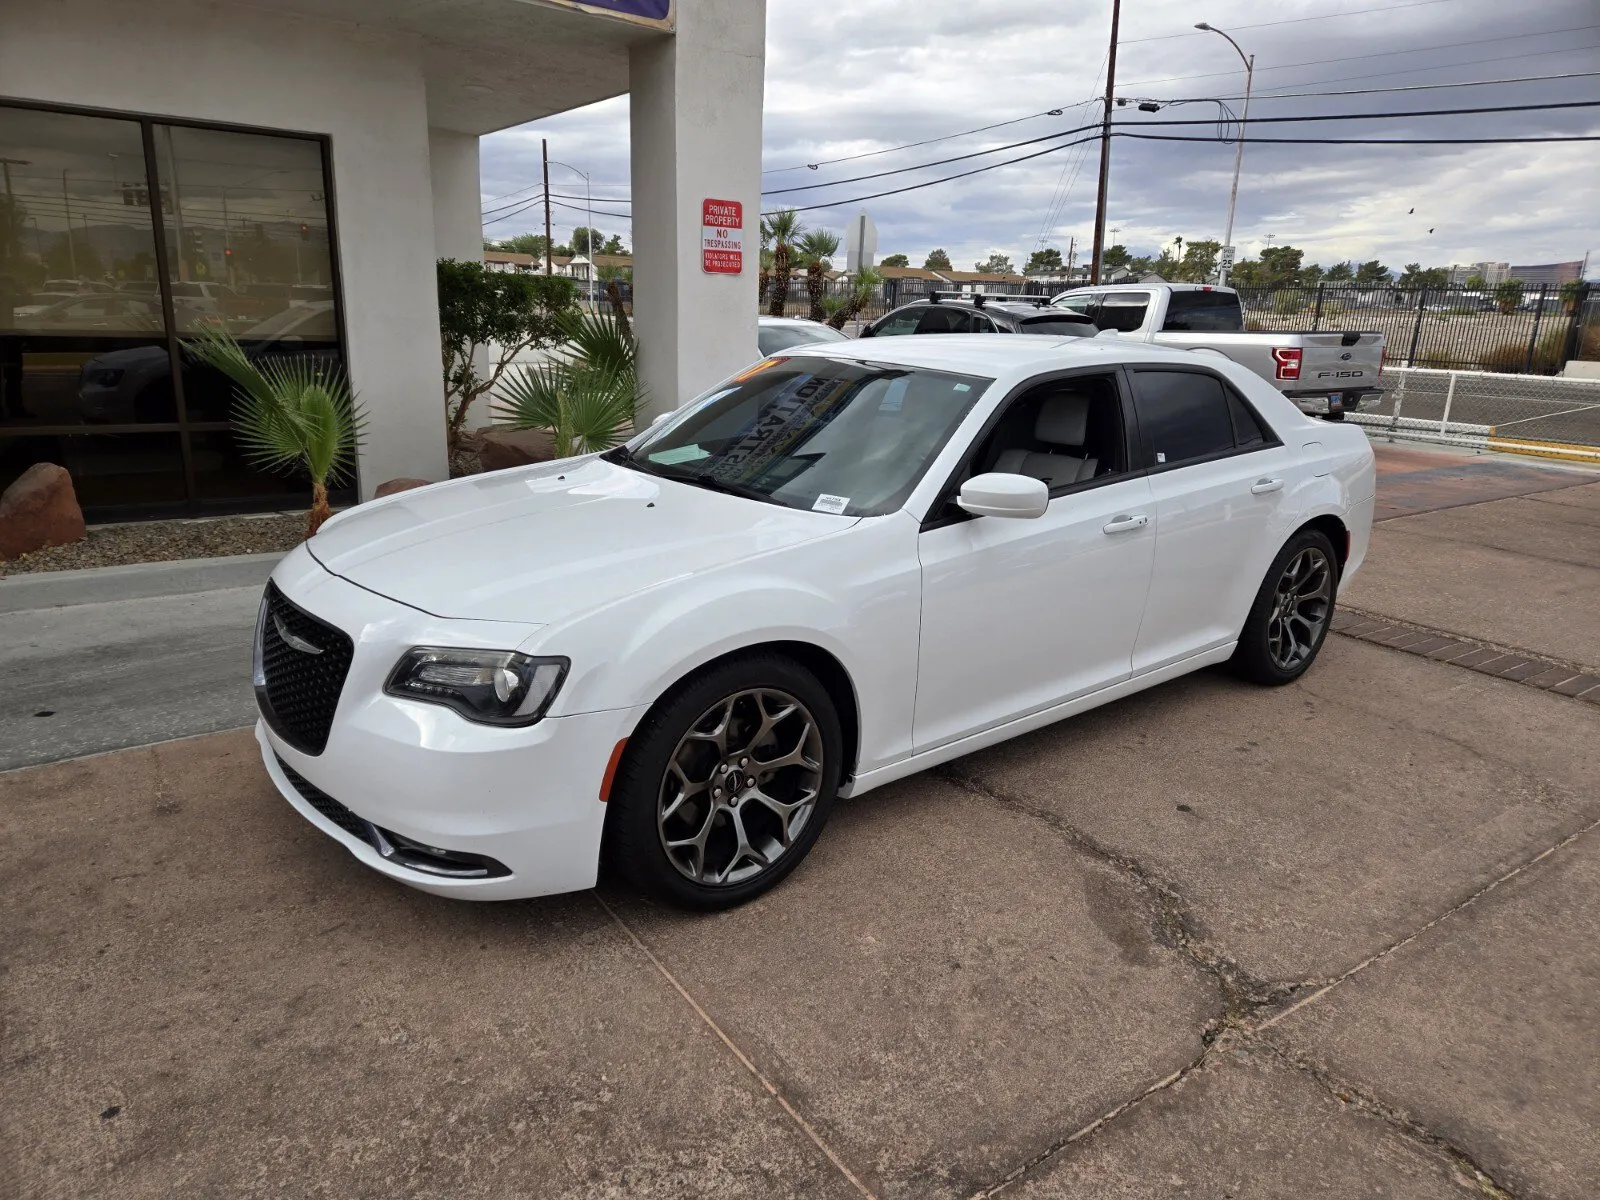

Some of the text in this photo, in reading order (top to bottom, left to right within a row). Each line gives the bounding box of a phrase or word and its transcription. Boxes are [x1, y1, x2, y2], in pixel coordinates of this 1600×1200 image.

[709, 205, 736, 216] PRIVATE
[705, 215, 740, 226] PROPERTY
[716, 229, 728, 239] NO
[704, 239, 741, 249] TRESPASSING
[1222, 259, 1232, 268] 25
